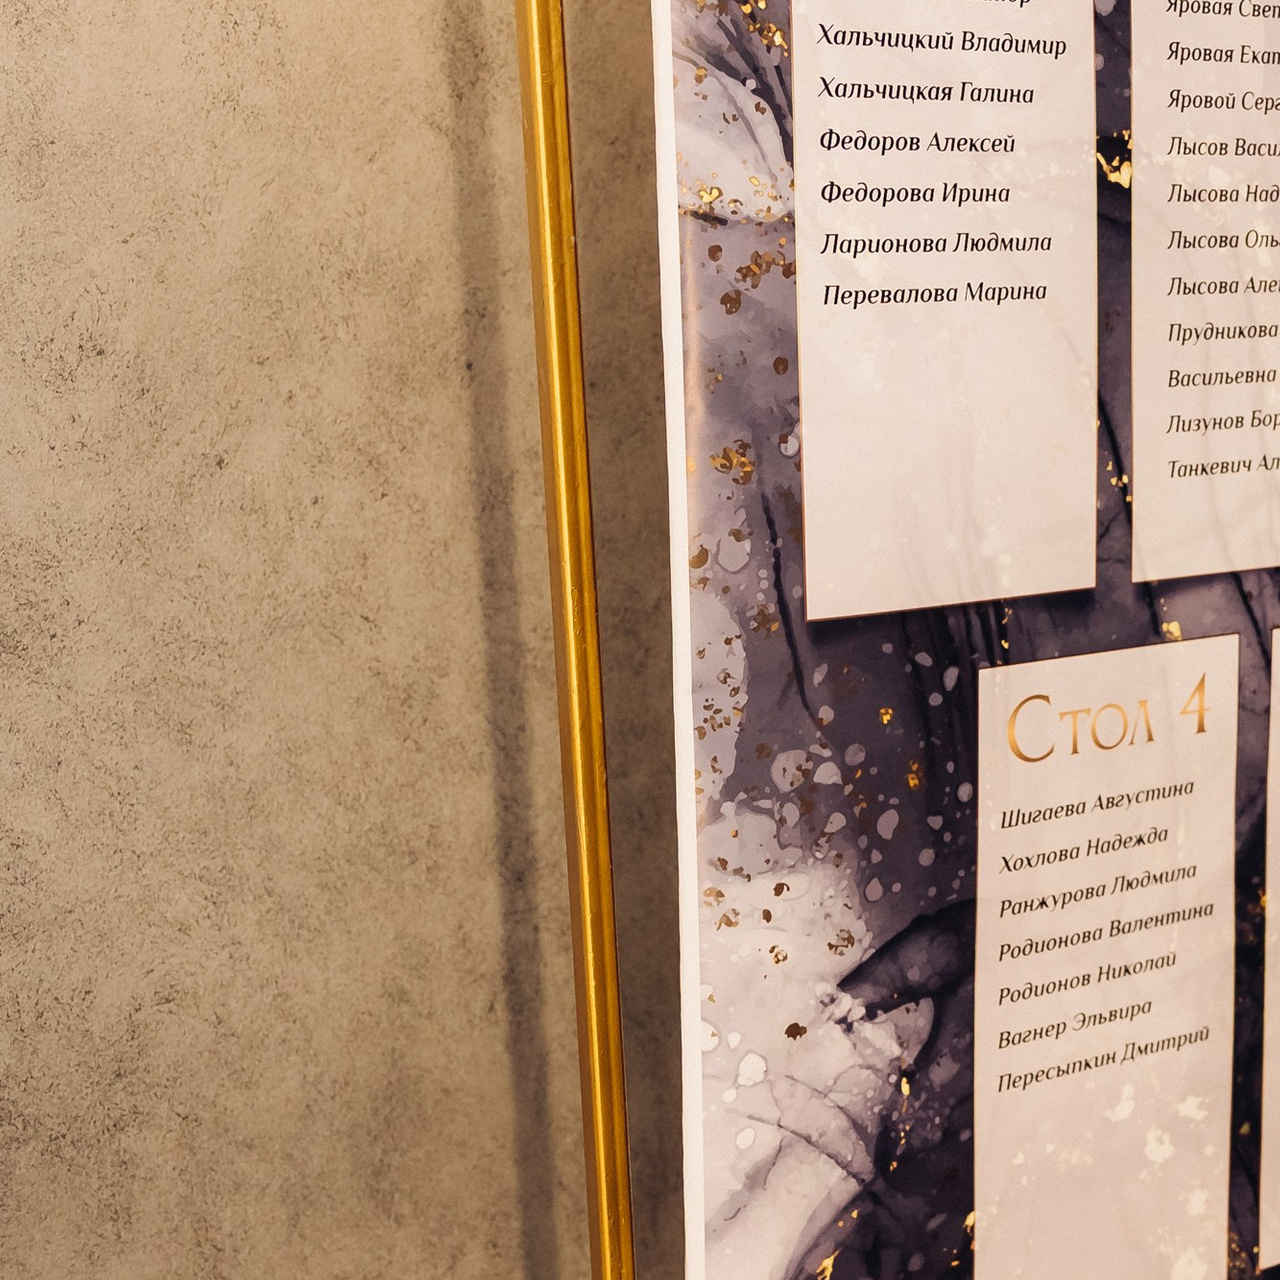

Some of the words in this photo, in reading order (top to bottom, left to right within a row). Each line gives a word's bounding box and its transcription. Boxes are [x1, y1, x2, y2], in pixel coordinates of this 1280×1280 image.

[817, 24, 953, 52] Хальчицкий
[962, 31, 1066, 59] Владимир
[1167, 42, 1234, 65] Яровая
[818, 77, 953, 104] Хальчицкая
[961, 82, 1034, 103] Галина
[1168, 89, 1235, 112] Яровой
[820, 129, 920, 156] Федоров
[927, 132, 1015, 152] Алексей
[1167, 137, 1228, 155] Лысов
[821, 181, 934, 207] Федорова
[943, 183, 1010, 207] Ирина
[1168, 184, 1239, 202] Лысова
[820, 234, 947, 258] Ларионова
[953, 232, 1051, 252] Людмила
[1167, 231, 1239, 249] Лысова
[824, 285, 957, 309] Перевалова
[965, 282, 1046, 305] Марина
[1167, 277, 1239, 295] Лысова
[1169, 322, 1278, 346] Прудникова
[1169, 368, 1276, 387] Васильевна
[1166, 415, 1244, 436] Лизунов
[1169, 458, 1251, 478] Танкевич
[1006, 694, 1154, 763] Стол
[1180, 672, 1209, 734] 4
[1001, 802, 1086, 829] Шигаева
[1092, 782, 1194, 811] Августина
[999, 847, 1080, 873] Хохлова
[1087, 827, 1168, 856] Надежда
[1000, 884, 1106, 918] Ранжурова
[1111, 866, 1196, 895] Людмила
[999, 928, 1102, 962] Родионова
[1109, 904, 1213, 937] Валентина
[999, 974, 1091, 1005] Родионов
[1098, 951, 1176, 983] Николай
[998, 1022, 1066, 1050] Вагнер
[1073, 1001, 1152, 1031] Эльвира
[999, 1052, 1116, 1092] Пересыпкин
[1120, 1026, 1209, 1065] Дмитрий
